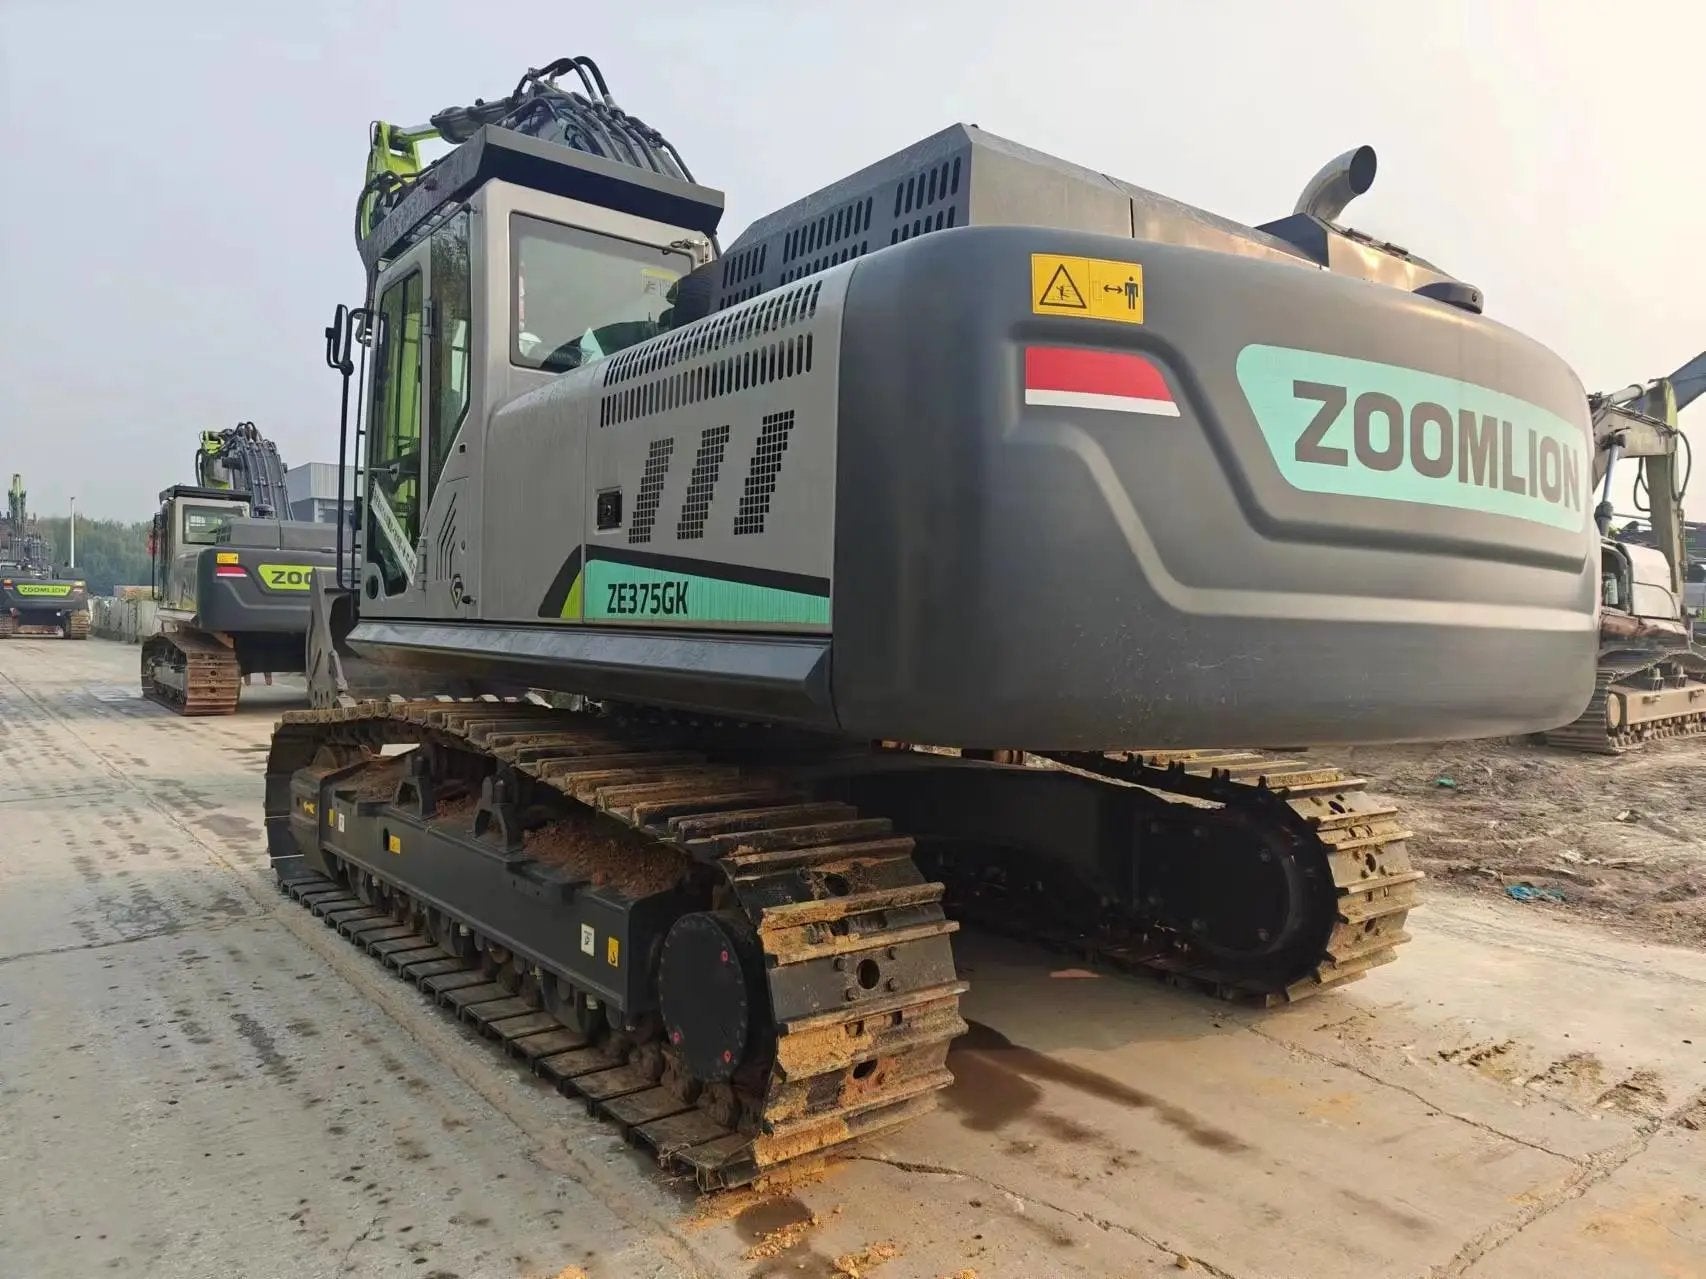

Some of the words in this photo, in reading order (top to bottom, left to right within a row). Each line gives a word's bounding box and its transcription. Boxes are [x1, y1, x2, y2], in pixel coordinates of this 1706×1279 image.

[1293, 379, 1581, 512] ZOOMLION
[22, 586, 67, 594] ZOOMLION
[607, 581, 689, 614] ZE375GK
